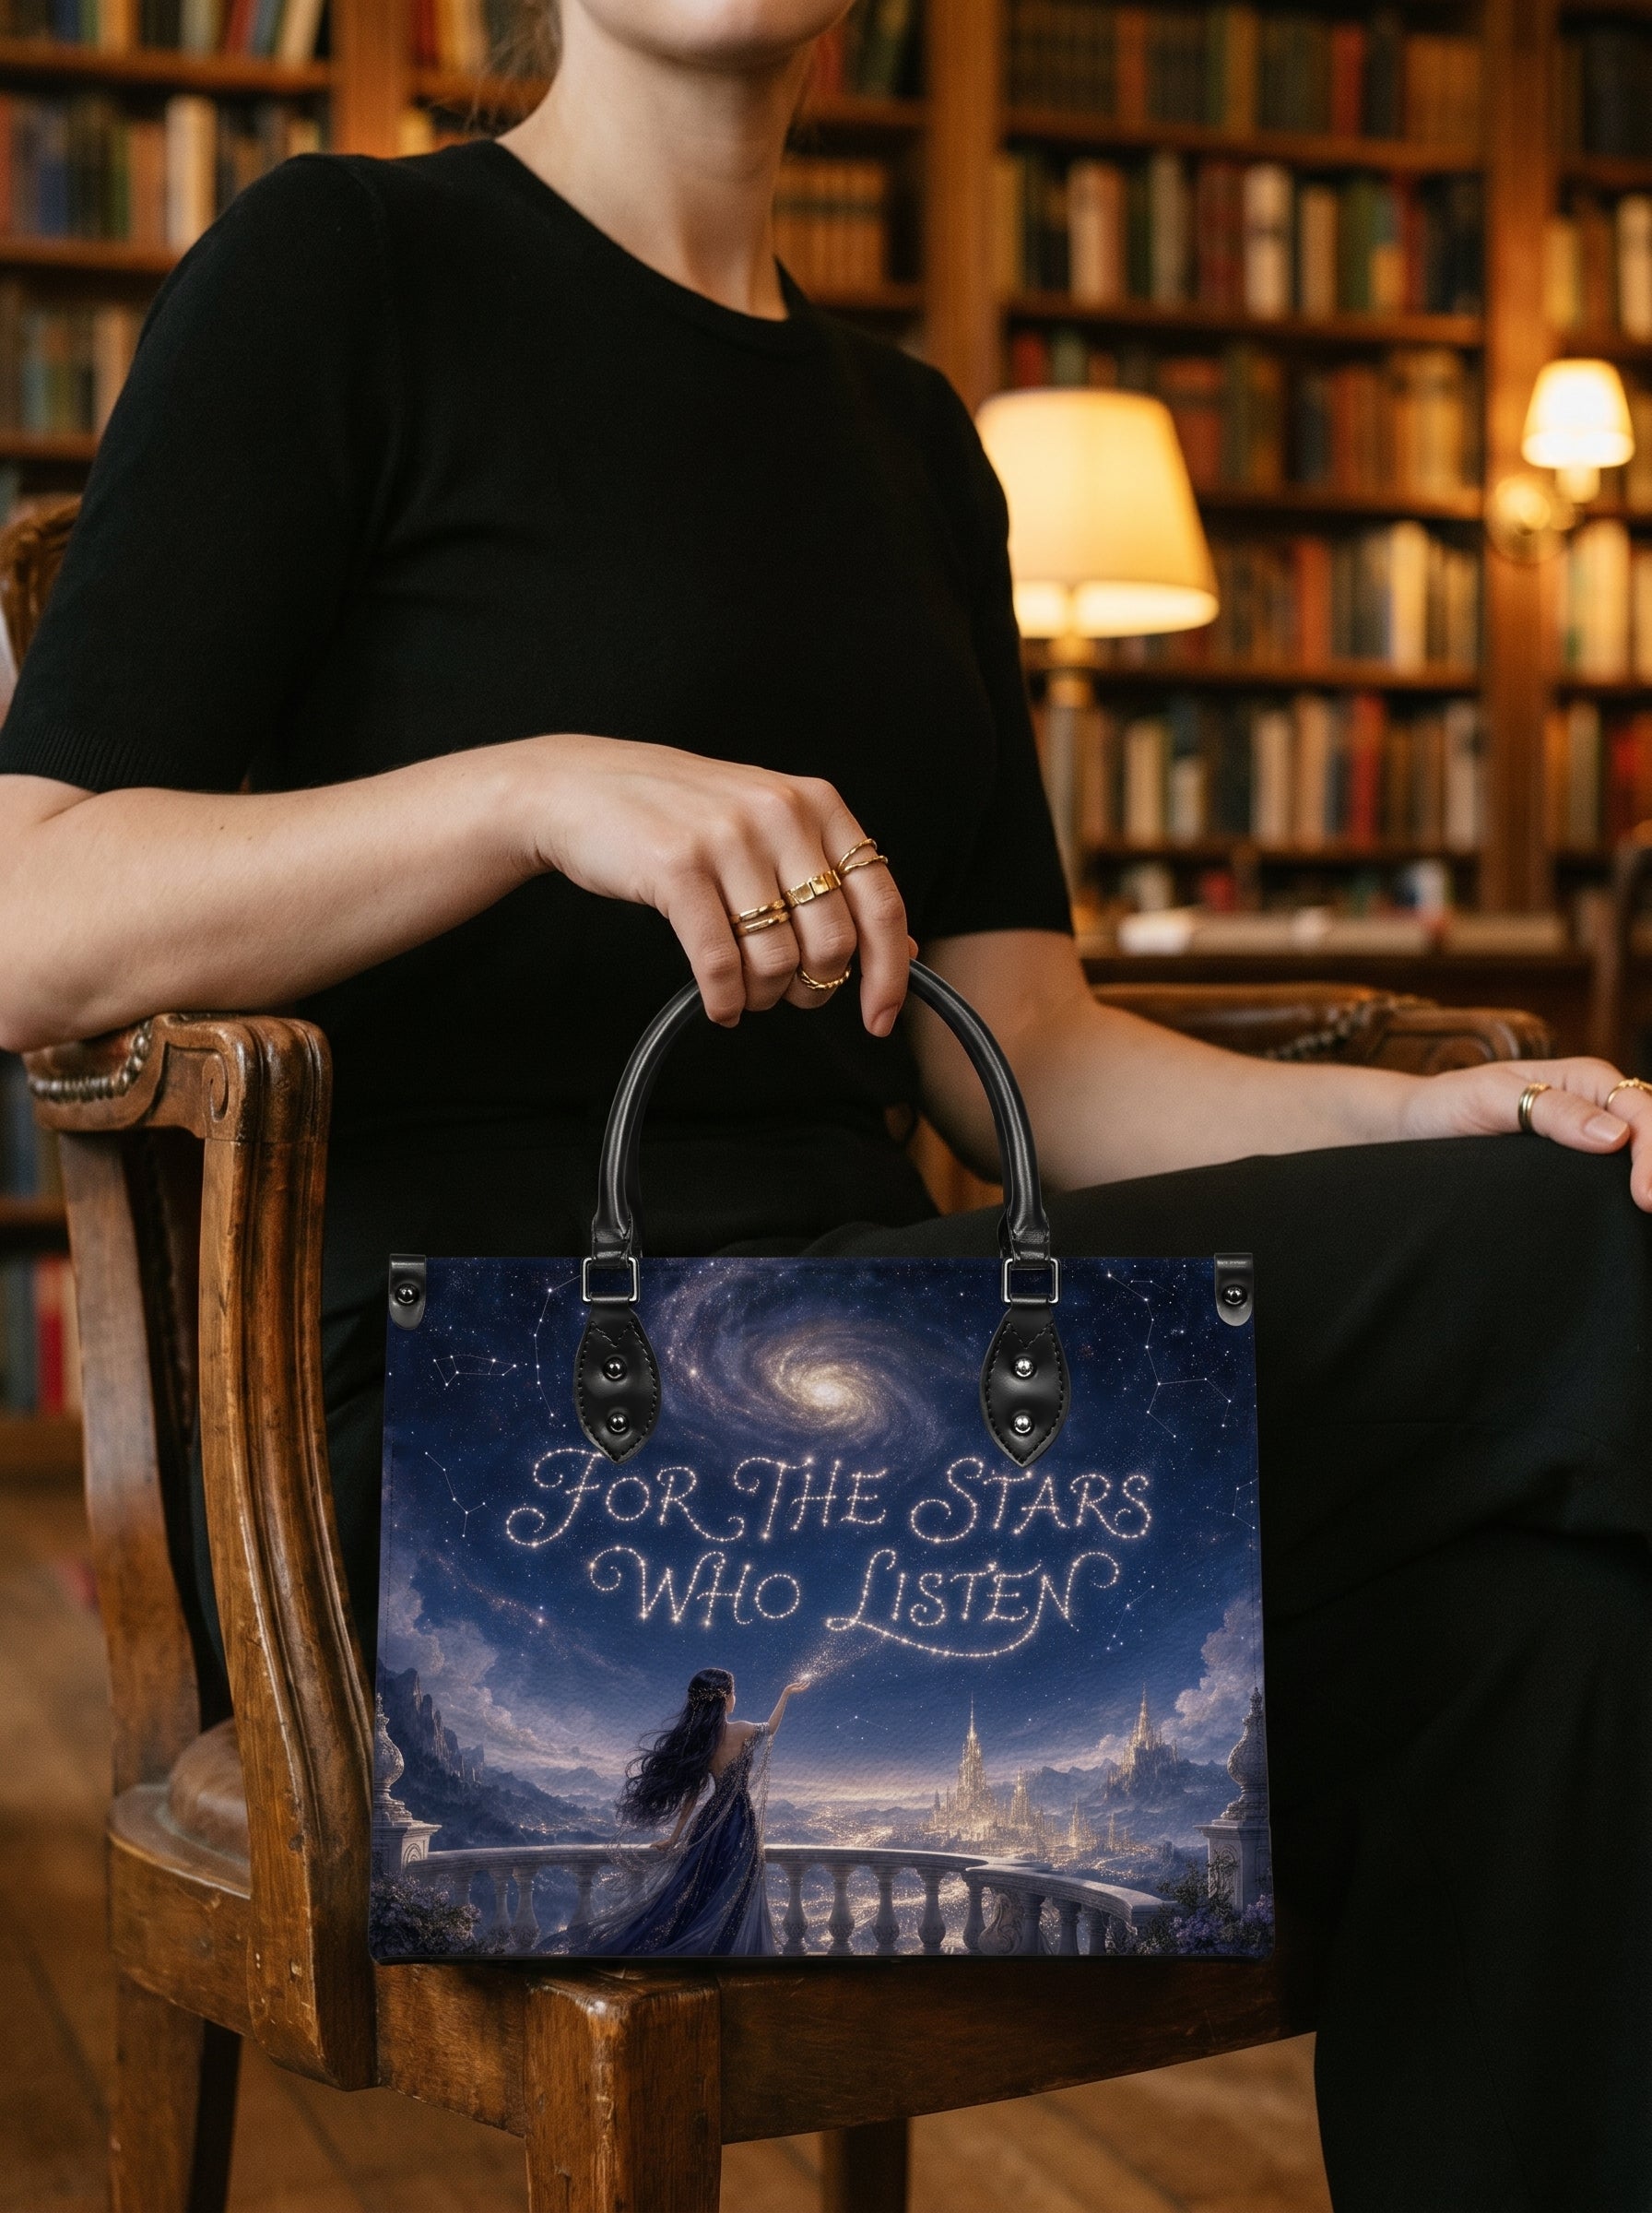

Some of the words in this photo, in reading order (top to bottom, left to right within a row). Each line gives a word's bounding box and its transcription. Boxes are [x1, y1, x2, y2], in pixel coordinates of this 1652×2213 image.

[505, 1448, 745, 1546] FOR
[735, 1456, 889, 1542] THE
[910, 1456, 1151, 1543] STARS
[588, 1545, 801, 1627] WHO
[825, 1548, 1120, 1658] LISTEN
